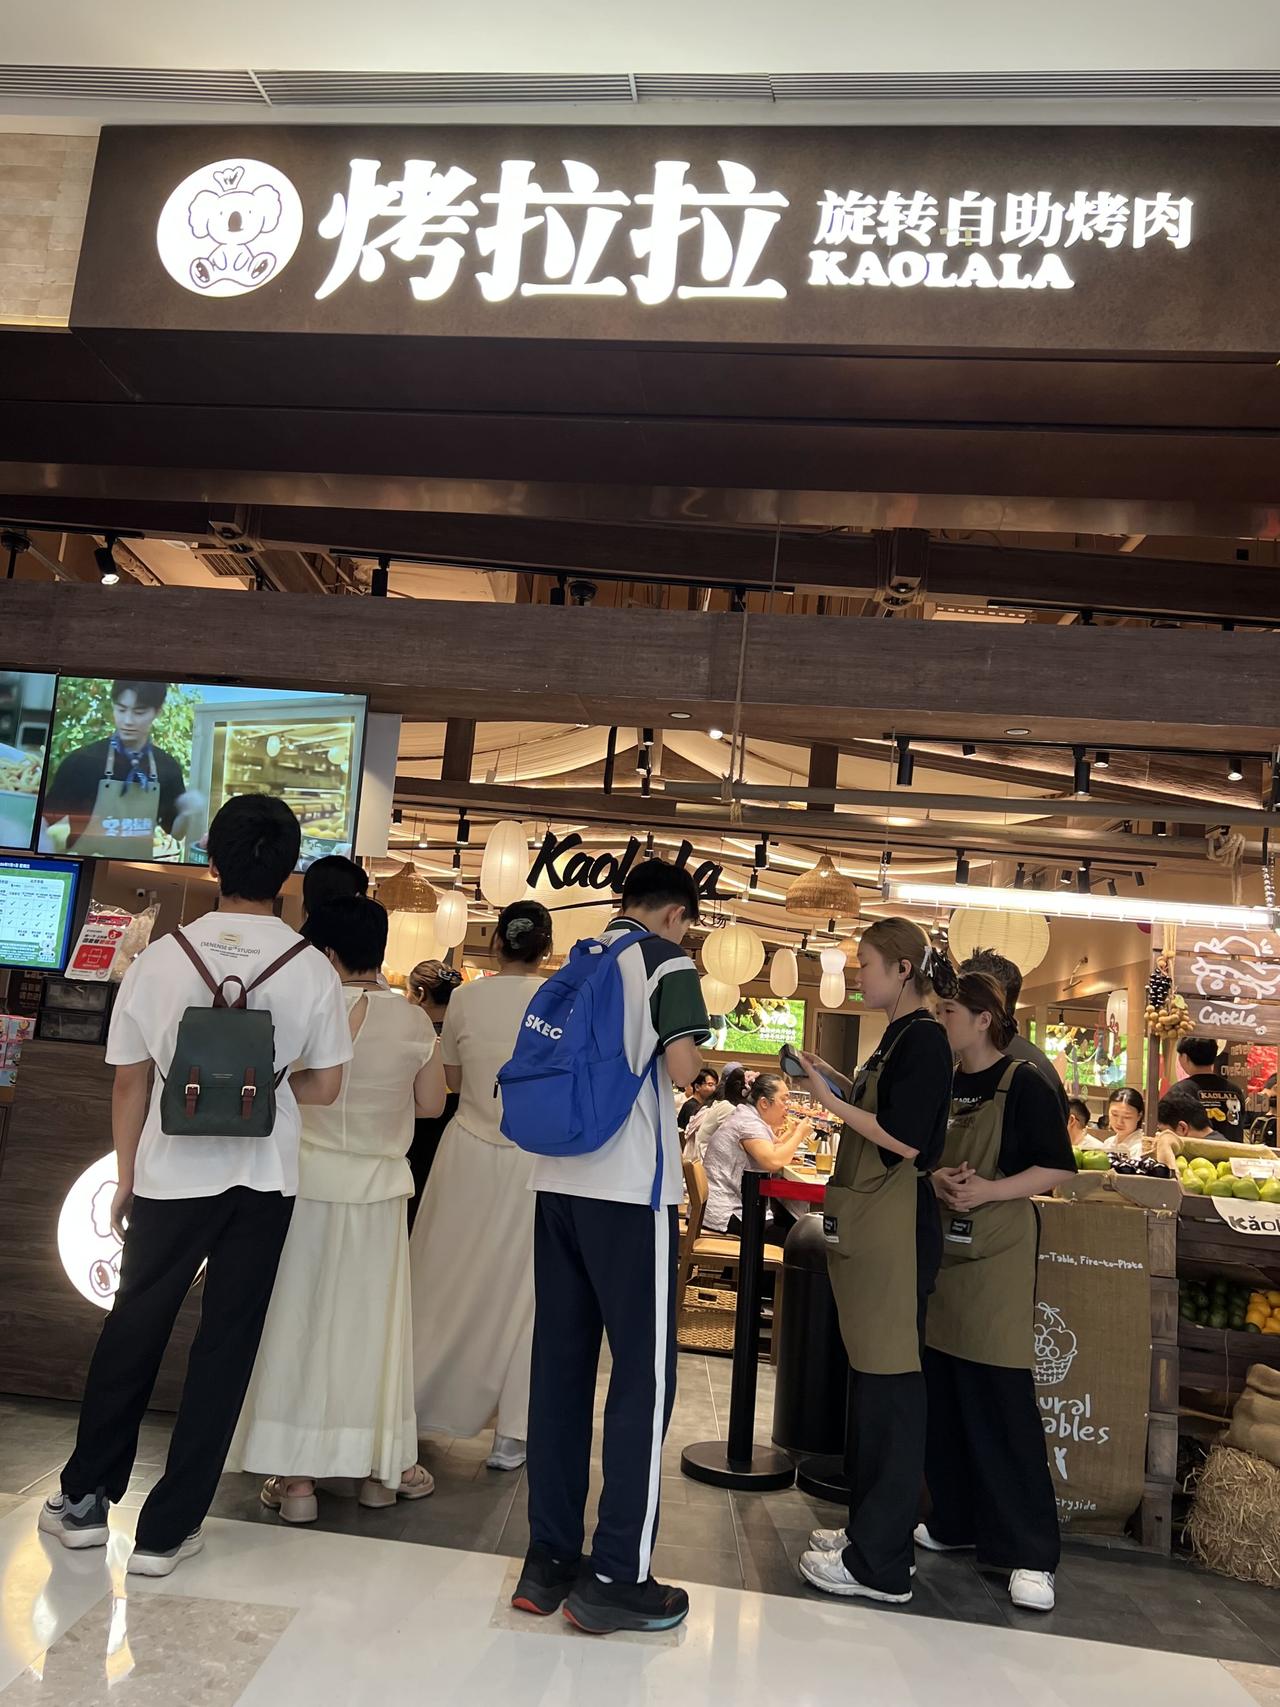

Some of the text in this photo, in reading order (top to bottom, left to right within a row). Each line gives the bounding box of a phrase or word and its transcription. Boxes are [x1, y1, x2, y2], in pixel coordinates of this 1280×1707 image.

[315, 158, 789, 304] 烤拉拉
[815, 189, 1195, 250] 旋转自助烤肉
[807, 249, 1076, 290] KAOLALA
[1198, 1006, 1257, 1026] Cattle
[1037, 1394, 1091, 1418] ural
